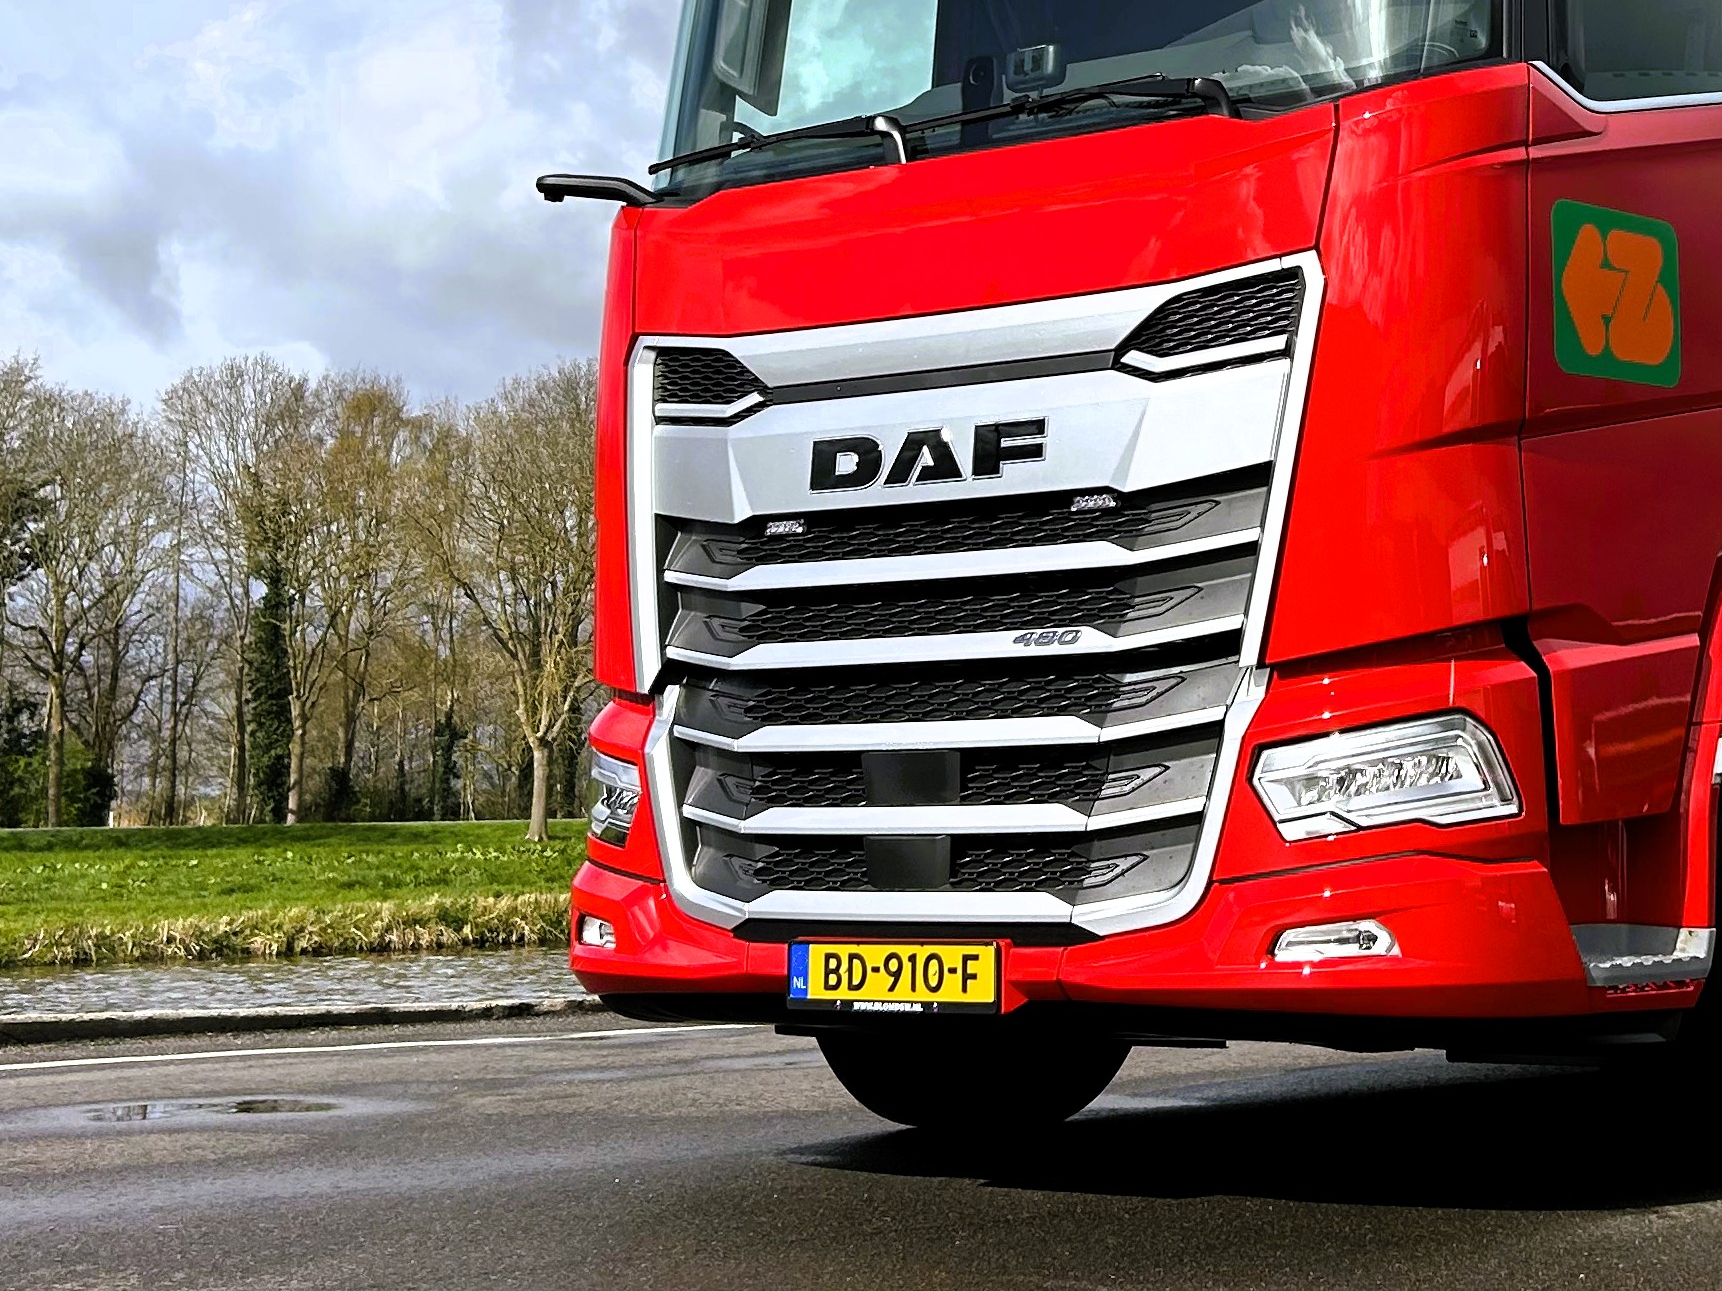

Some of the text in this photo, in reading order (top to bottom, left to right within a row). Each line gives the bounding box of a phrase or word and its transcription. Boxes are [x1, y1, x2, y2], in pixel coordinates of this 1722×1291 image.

[809, 416, 1050, 495] DAF
[1012, 629, 1083, 647] 480
[792, 975, 807, 989] NL
[823, 951, 980, 994] BD-910-F
